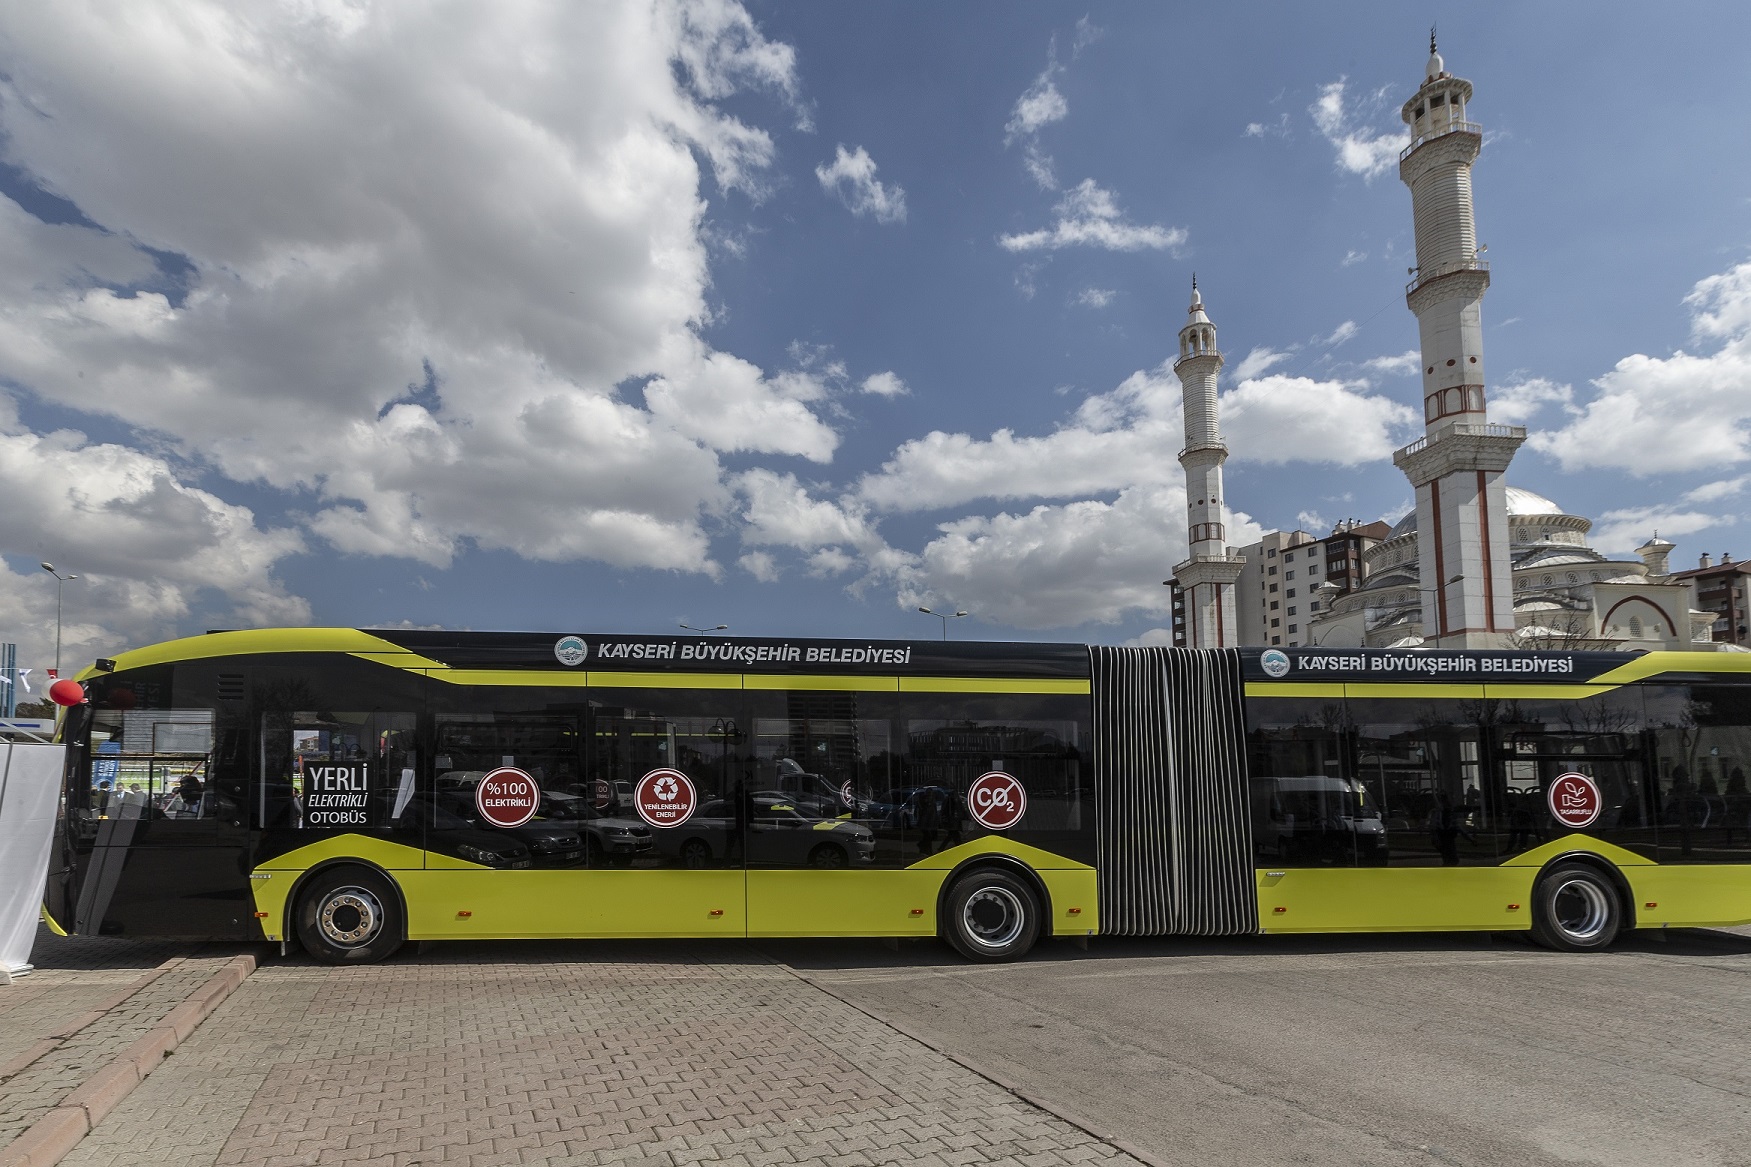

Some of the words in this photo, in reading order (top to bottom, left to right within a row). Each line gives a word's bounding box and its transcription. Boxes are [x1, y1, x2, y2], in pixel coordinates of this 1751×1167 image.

[598, 641, 677, 659] KAYSERİ
[680, 642, 801, 665] BÜYÜKŞEHİR
[805, 645, 911, 664] BELEDİYESİ
[1298, 653, 1366, 671] KAYSERİ
[1371, 654, 1477, 675] BÜYÜKŞEHİR
[1481, 655, 1573, 673] BELEDİYESİ
[309, 762, 368, 791] YERLİ
[486, 782, 528, 795] %100
[308, 792, 369, 807] ELEKTRİKLİ
[485, 797, 531, 807] ELEKTRİKLİ
[310, 809, 367, 824] OTOBÜS
